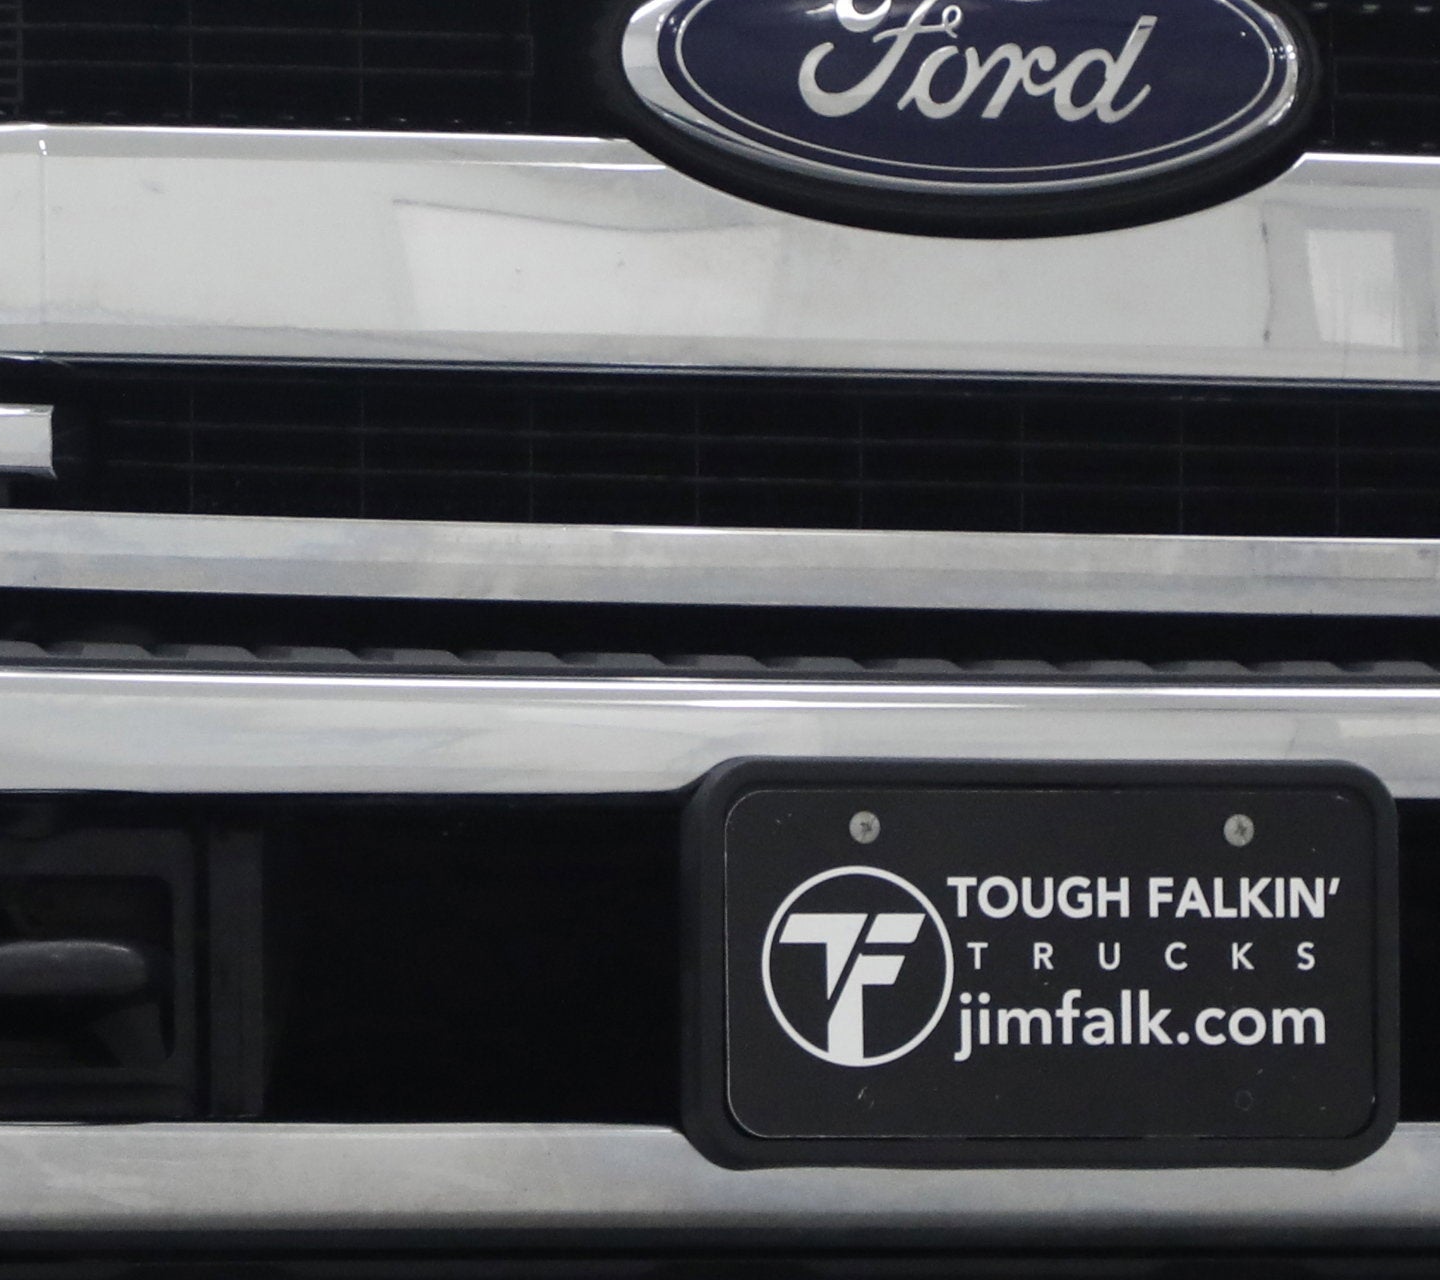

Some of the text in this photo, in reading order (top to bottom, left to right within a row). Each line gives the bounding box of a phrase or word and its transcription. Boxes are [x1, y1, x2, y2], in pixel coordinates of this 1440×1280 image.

[947, 876, 1341, 919] TOUGH FALKIN'
[967, 941, 1317, 971] TRUCKS
[955, 990, 1327, 1062] jimfalk.com
